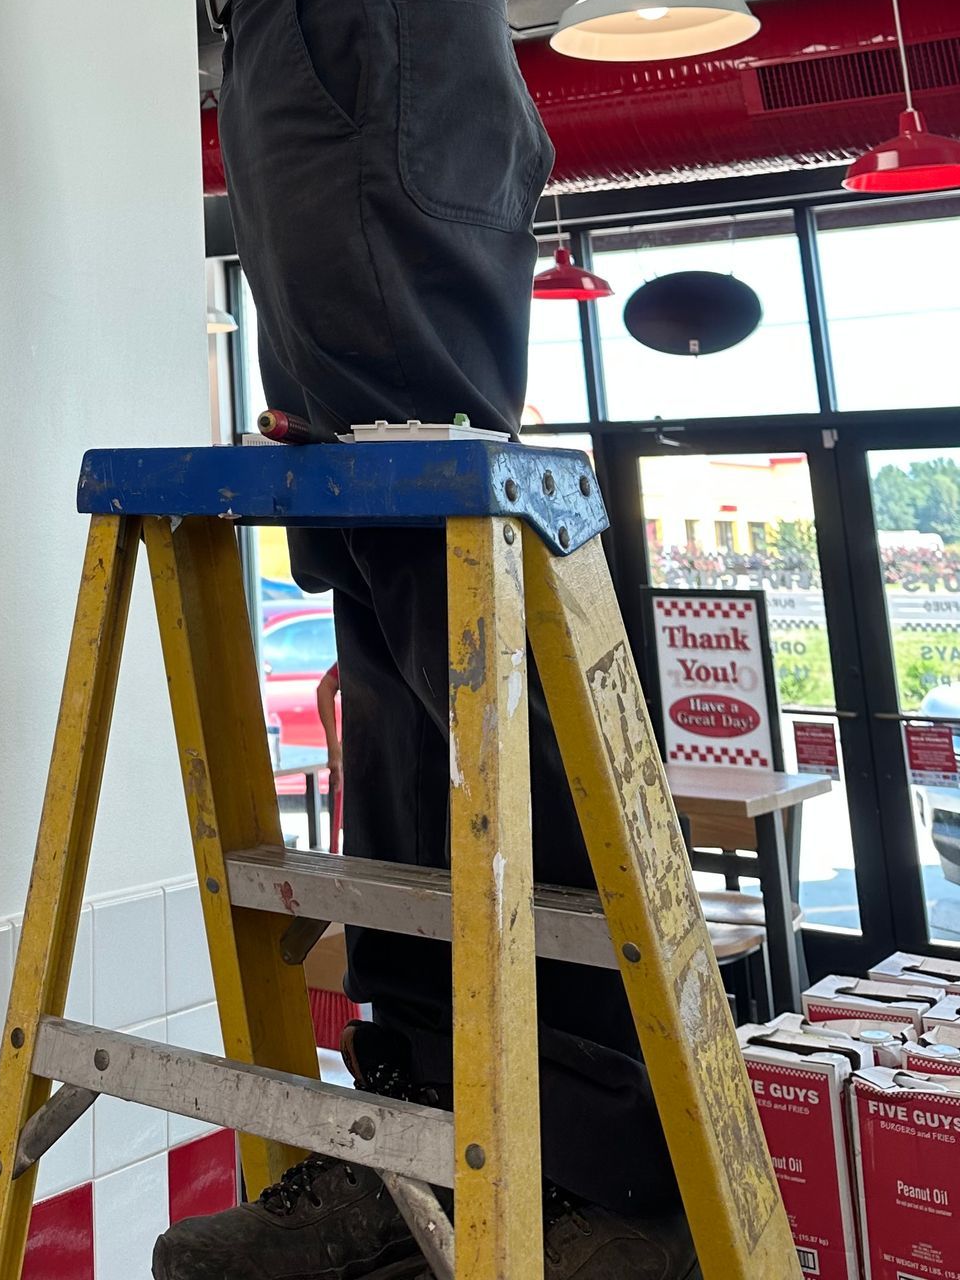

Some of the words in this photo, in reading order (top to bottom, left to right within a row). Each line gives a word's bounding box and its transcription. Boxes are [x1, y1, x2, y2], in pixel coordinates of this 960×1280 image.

[662, 625, 751, 651] Thank
[677, 658, 738, 683] You!
[689, 697, 726, 713] Have
[731, 704, 739, 713] a
[677, 712, 716, 726] Great
[722, 714, 754, 731] Day!
[769, 1083, 819, 1104] GUYS
[774, 1102, 787, 1111] and
[788, 1105, 810, 1115] FRIES
[868, 1100, 908, 1121] FIVE
[880, 1121, 916, 1135] BURGERS
[933, 1132, 956, 1143] FRIES
[789, 1157, 803, 1173] Oil
[897, 1180, 931, 1202] Peanut
[933, 1189, 948, 1205] Oil
[883, 1253, 895, 1263] NET
[895, 1256, 919, 1269] WEIGHT
